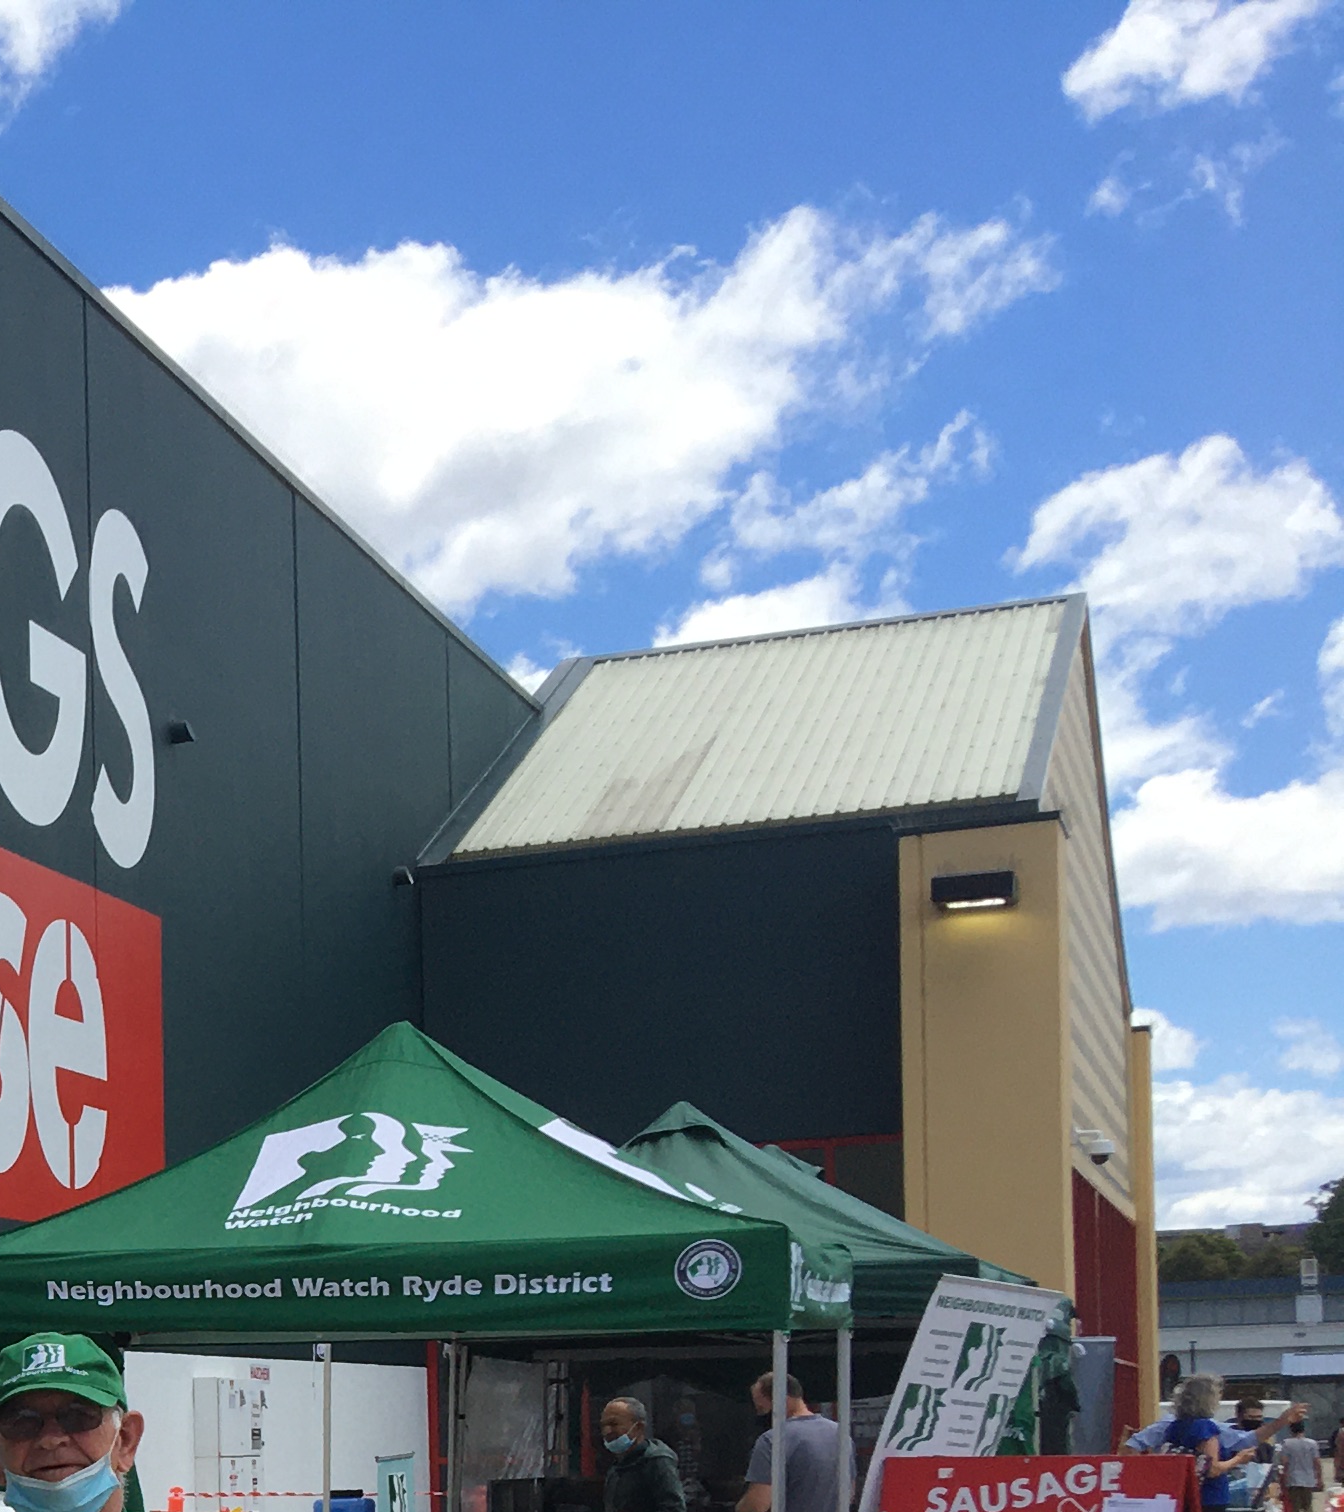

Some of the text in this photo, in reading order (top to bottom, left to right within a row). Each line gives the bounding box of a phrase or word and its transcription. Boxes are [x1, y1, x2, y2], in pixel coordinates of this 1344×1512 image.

[224, 1211, 313, 1230] Watch
[226, 1198, 462, 1221] Neighbourhood
[46, 1272, 613, 1306] Neighbourhood Watch Ryde District
